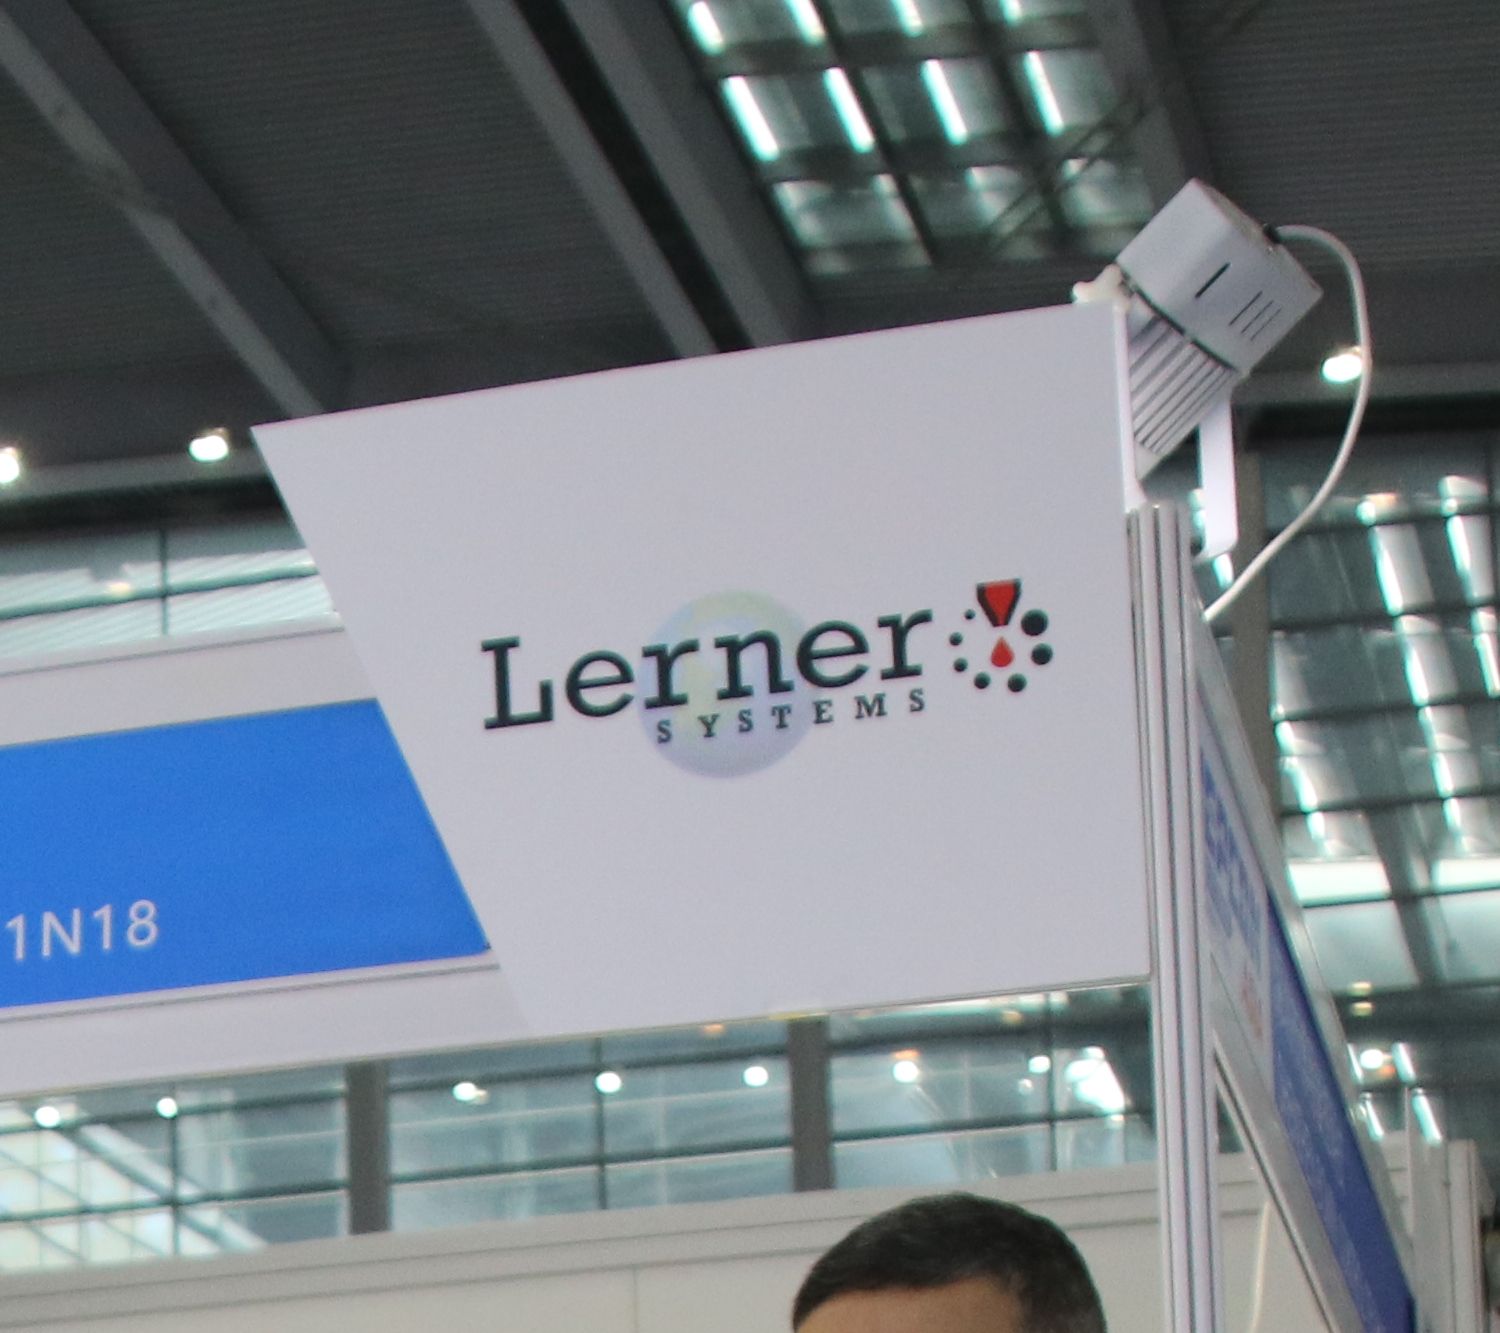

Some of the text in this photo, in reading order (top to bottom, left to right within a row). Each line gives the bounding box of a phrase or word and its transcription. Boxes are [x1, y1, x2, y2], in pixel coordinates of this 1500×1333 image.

[481, 608, 932, 730] Lerner
[658, 688, 925, 743] SYSTEMS
[6, 900, 160, 962] 1N18
